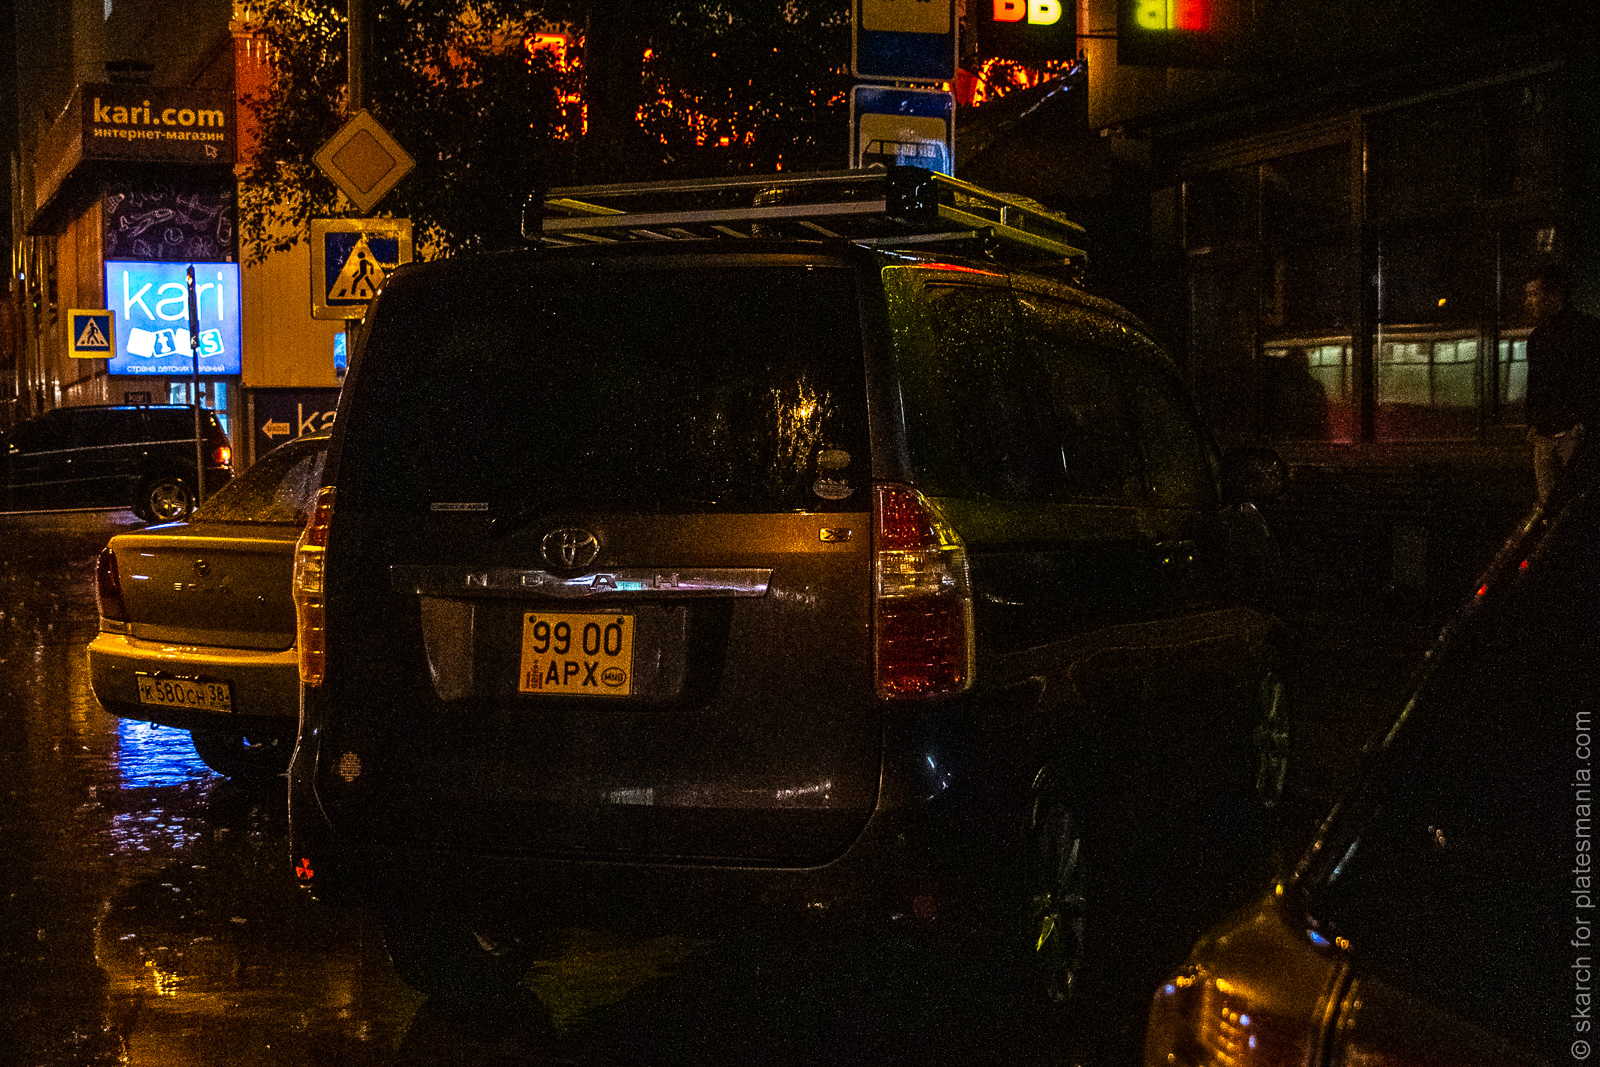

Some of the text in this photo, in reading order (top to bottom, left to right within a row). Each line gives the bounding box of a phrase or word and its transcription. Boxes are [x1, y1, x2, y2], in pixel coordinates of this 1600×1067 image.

[93, 97, 224, 127] kari.com
[93, 128, 225, 141] интернет-магазин
[123, 270, 224, 321] kari
[126, 364, 156, 374] страна
[533, 621, 622, 657] 99 00
[208, 685, 224, 702] 38
